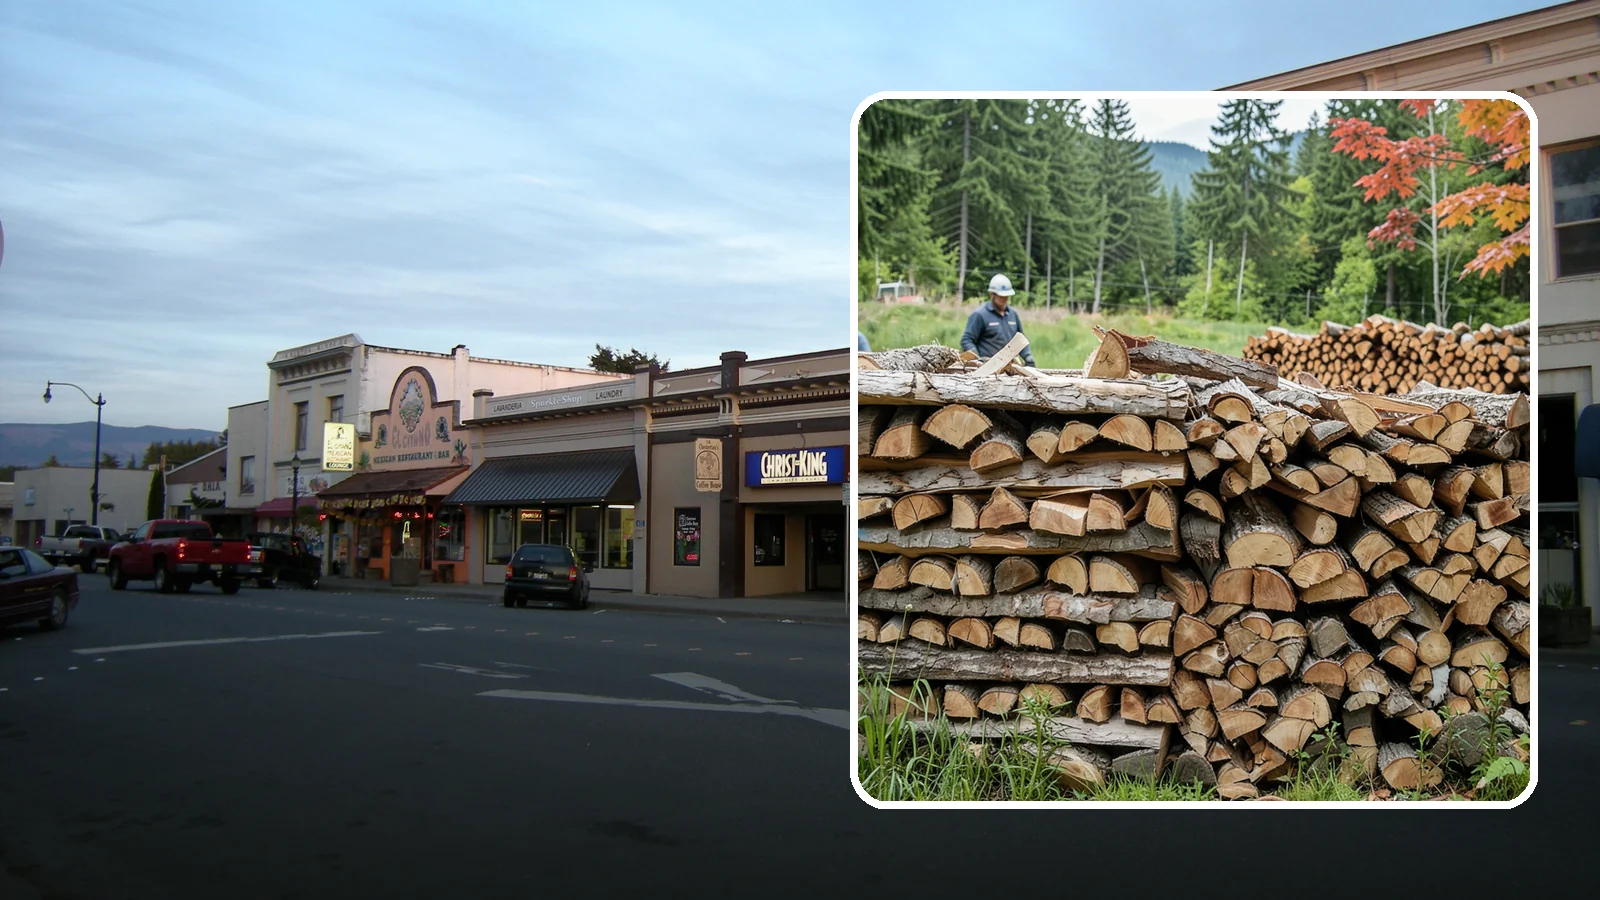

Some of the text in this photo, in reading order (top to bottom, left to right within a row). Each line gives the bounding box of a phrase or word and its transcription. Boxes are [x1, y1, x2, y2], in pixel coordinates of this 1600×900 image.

[595, 388, 623, 400] LAUNDRY
[493, 401, 522, 413] LAVANDERIA
[530, 394, 582, 409] Sparkle Shop
[327, 450, 352, 458] MEXICAN
[373, 455, 397, 464] MEXICAN
[397, 450, 433, 462] RESTAURANT
[437, 450, 450, 459] BAR
[761, 450, 827, 478] CHRIST KING
